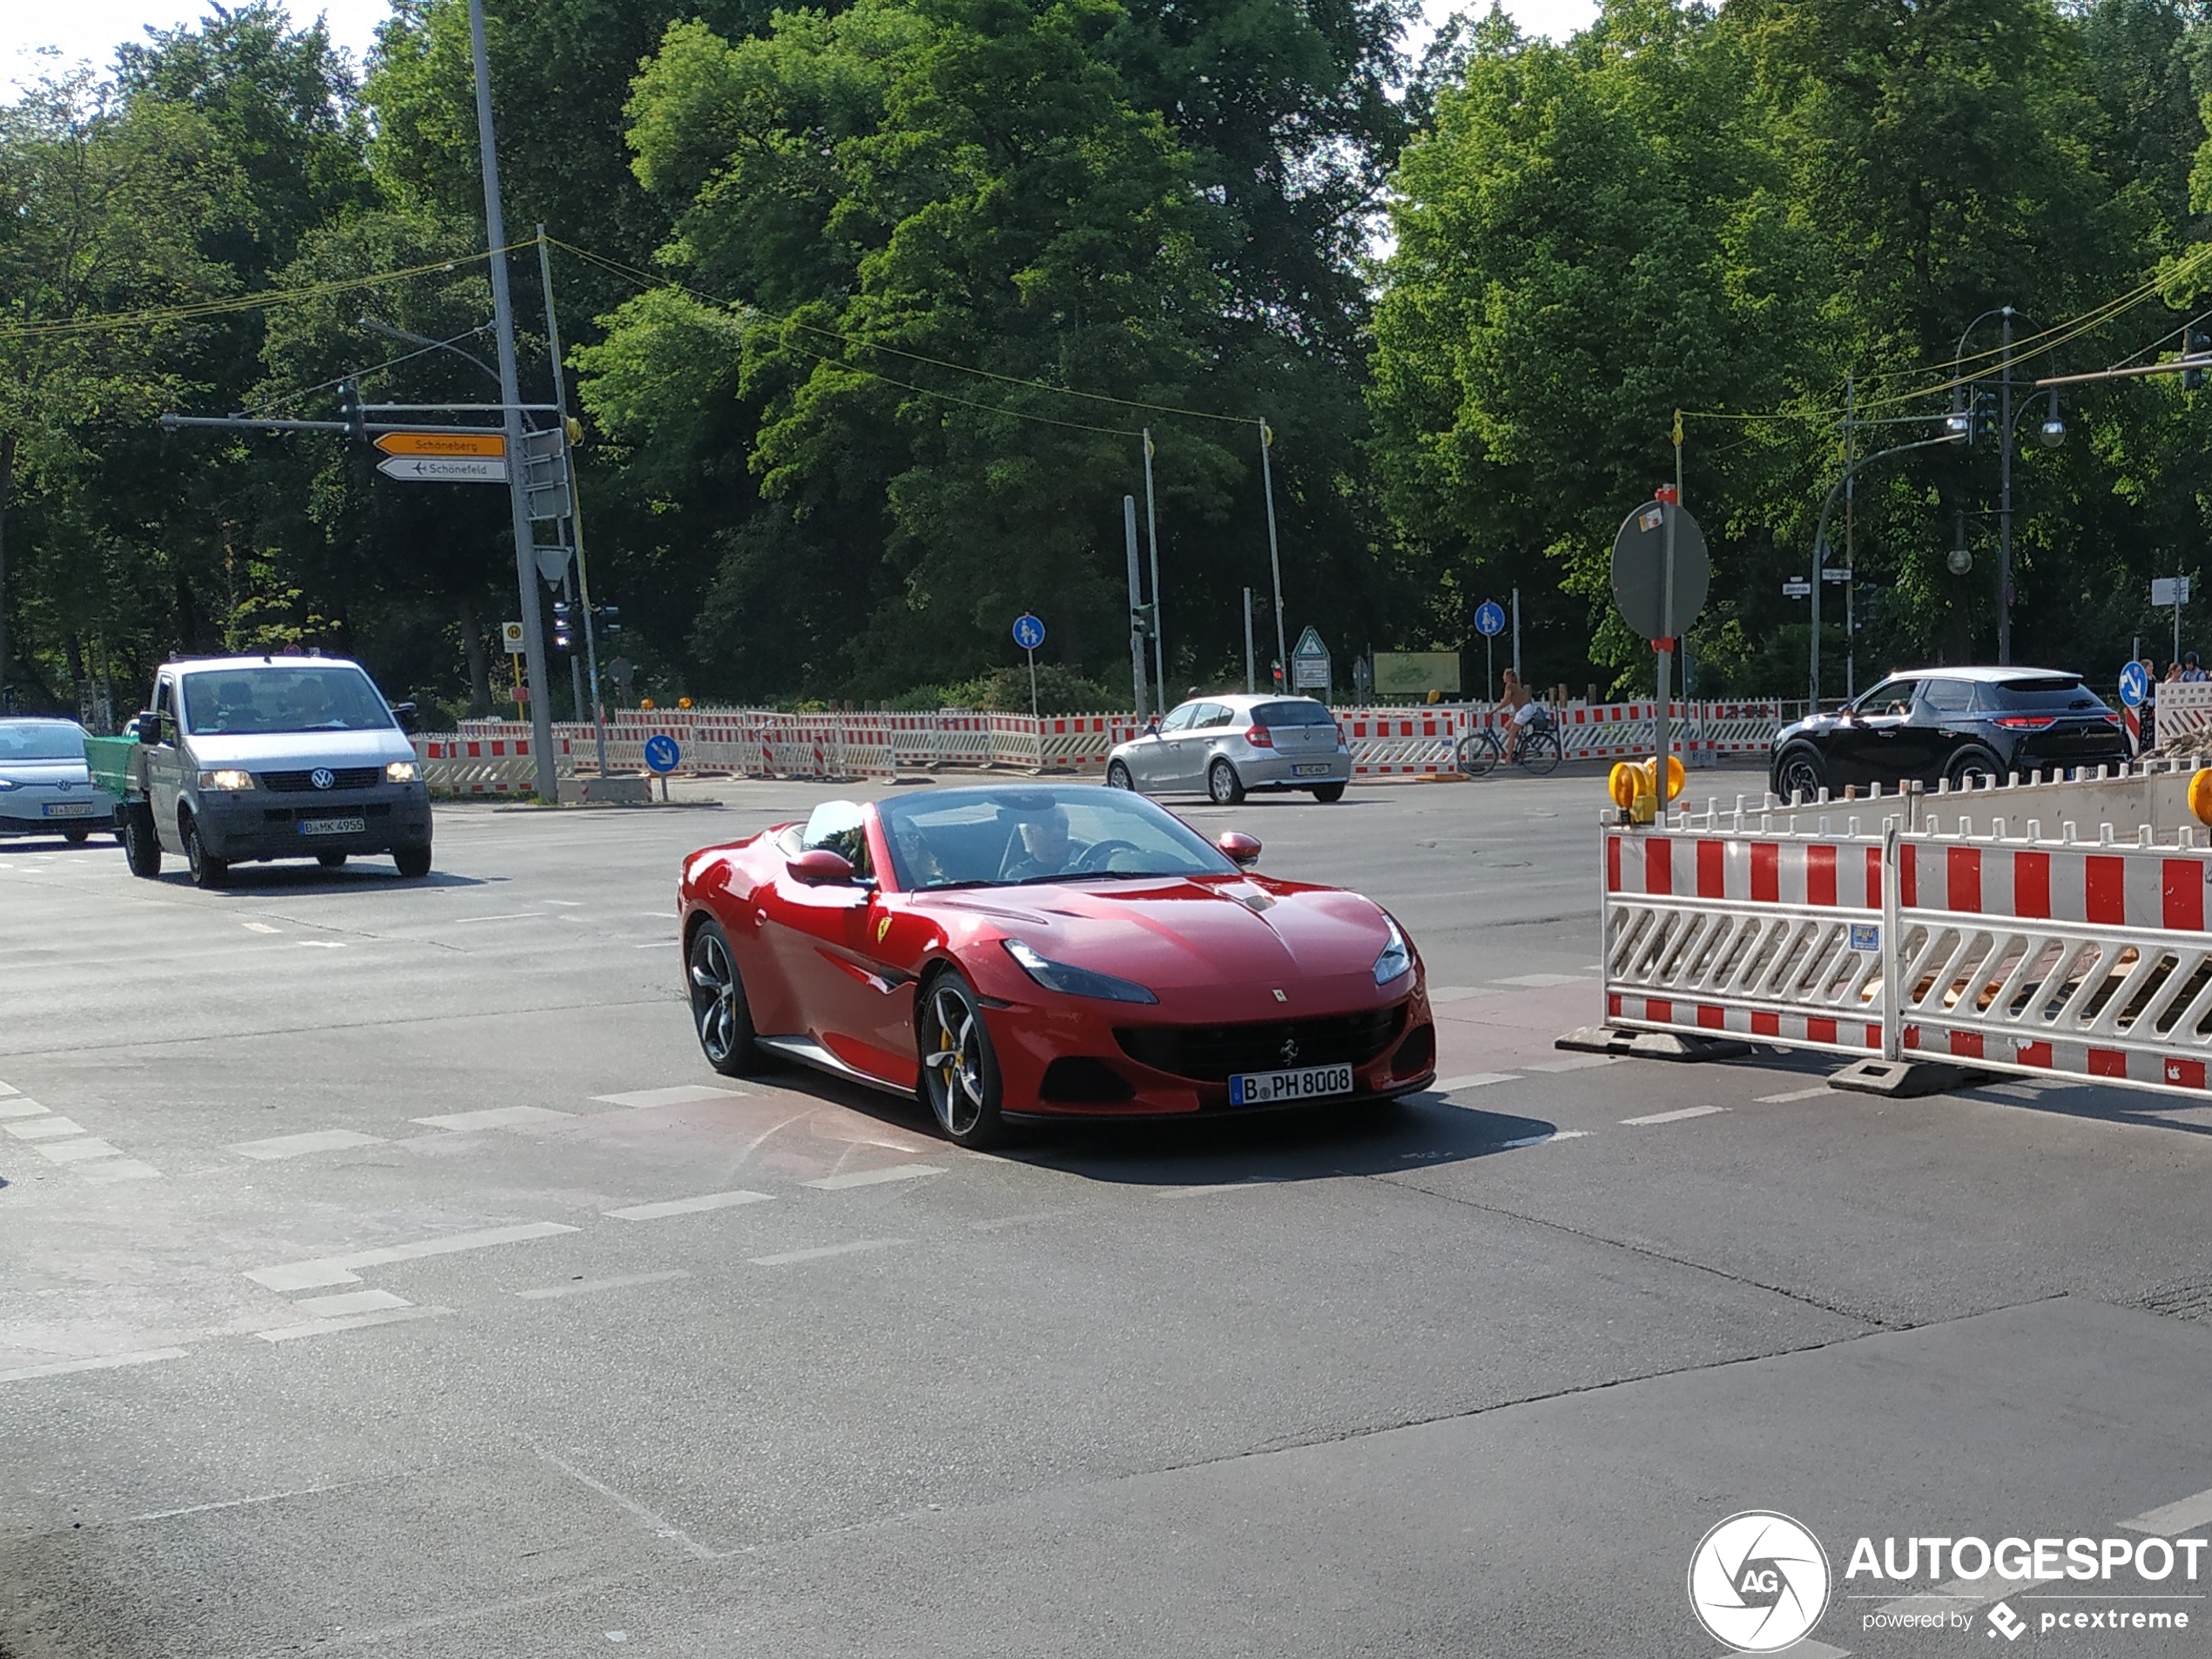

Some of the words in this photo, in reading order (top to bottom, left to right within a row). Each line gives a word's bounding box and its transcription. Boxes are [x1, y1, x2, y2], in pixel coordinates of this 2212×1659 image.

[415, 439, 478, 453] Schöneberg
[428, 463, 487, 475] Schönefeld
[305, 823, 313, 833] B
[320, 822, 334, 832] MK
[336, 820, 363, 831] 4955
[1244, 1078, 1258, 1101] B
[1271, 1074, 1298, 1098] PH
[1303, 1069, 1350, 1095] 8008
